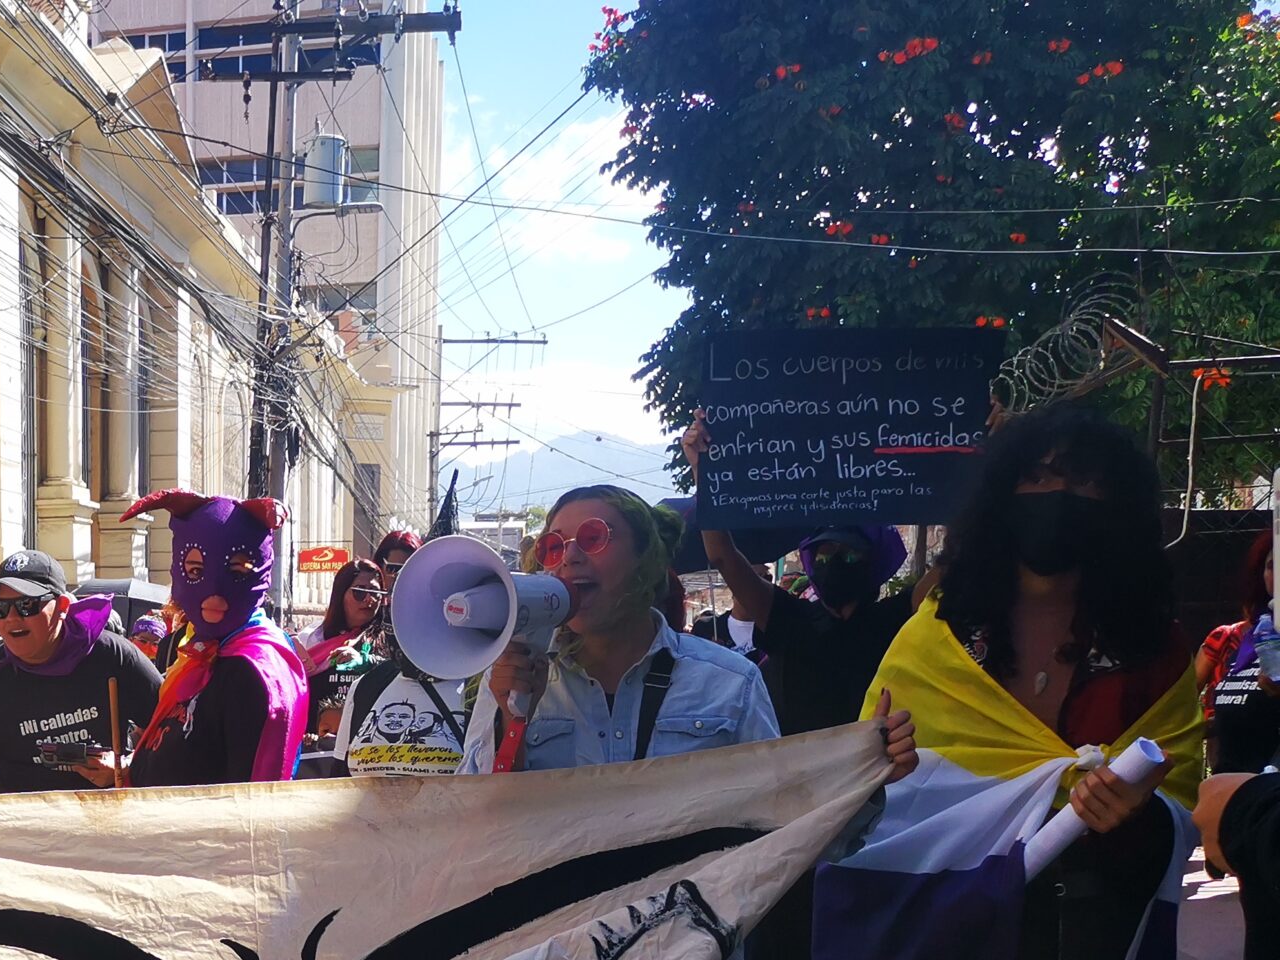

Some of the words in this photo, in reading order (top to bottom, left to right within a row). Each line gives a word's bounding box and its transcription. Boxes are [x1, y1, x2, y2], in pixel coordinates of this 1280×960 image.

[710, 343, 770, 382] Los
[782, 355, 883, 385] cuerpos
[895, 348, 927, 371] de
[705, 399, 831, 428] compañeras
[836, 393, 878, 416] aún
[888, 397, 920, 415] no
[932, 396, 966, 417] se
[708, 431, 796, 462] enfrian
[807, 440, 825, 463] y
[831, 431, 871, 449] sus
[707, 472, 734, 494] ya
[748, 458, 816, 480] están
[836, 453, 916, 479] libres...
[800, 487, 830, 500] corte
[836, 485, 867, 503] justa
[910, 482, 934, 496] las
[40, 706, 99, 732] calladas
[357, 755, 382, 766] vivos
[388, 754, 403, 763] los
[385, 745, 400, 754] los
[407, 745, 453, 754] llevaron
[363, 765, 396, 773] SNEIDER
